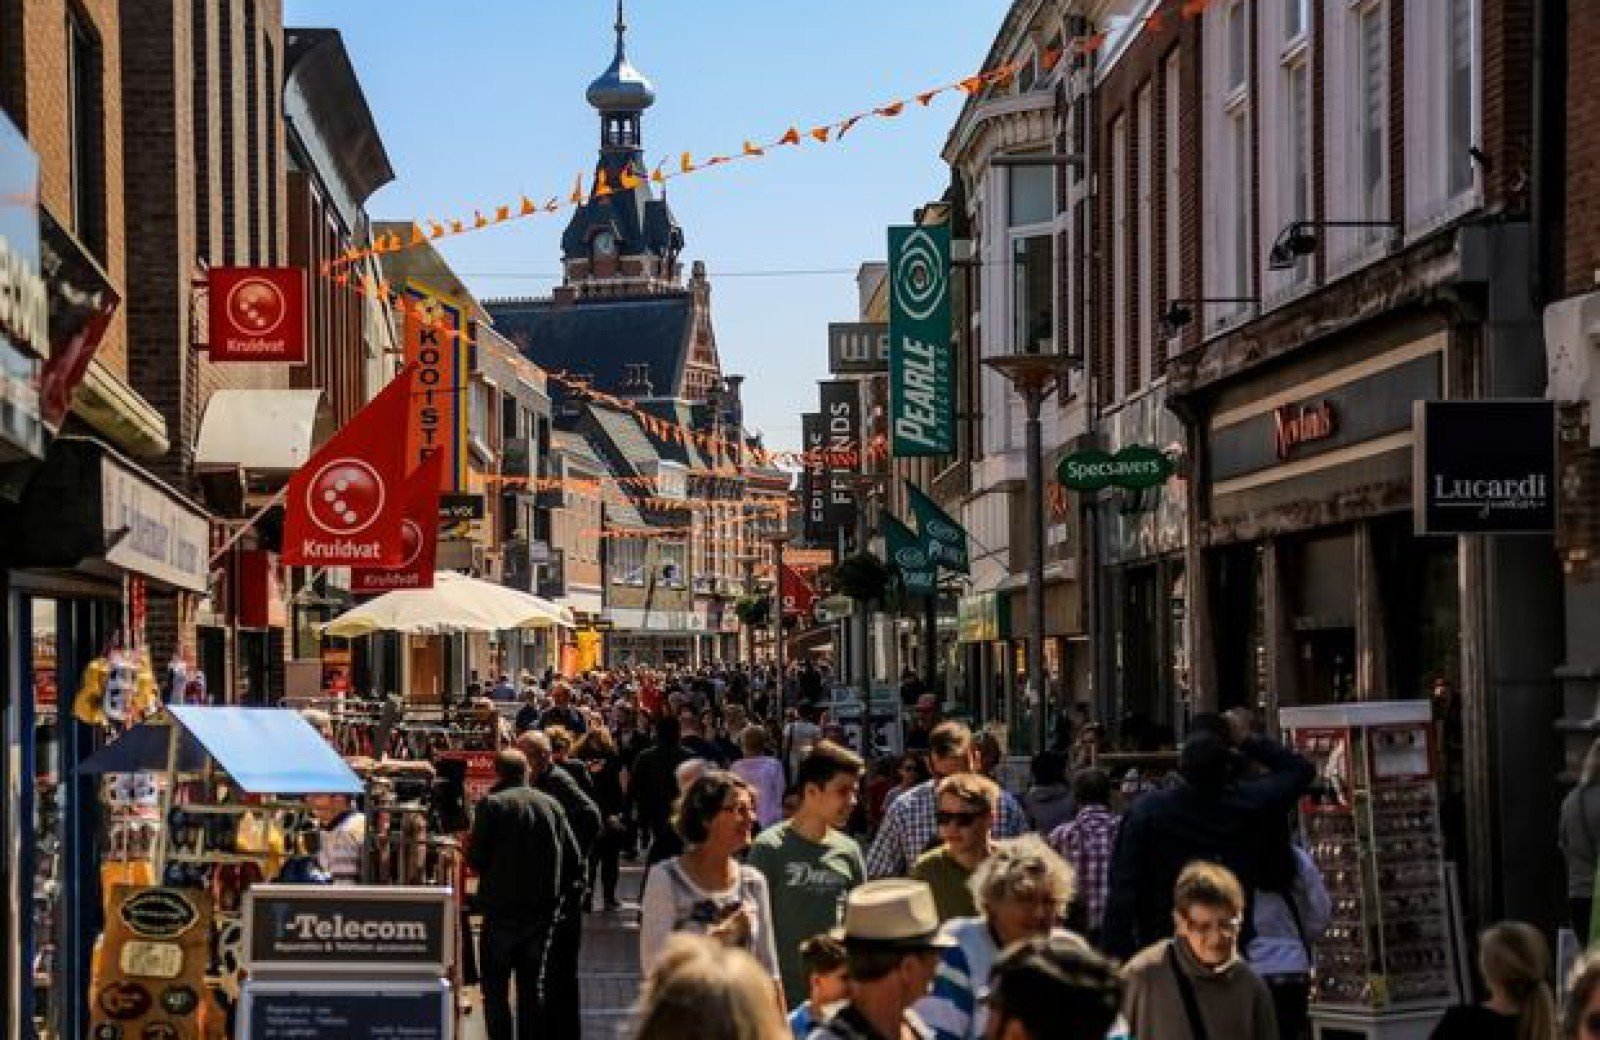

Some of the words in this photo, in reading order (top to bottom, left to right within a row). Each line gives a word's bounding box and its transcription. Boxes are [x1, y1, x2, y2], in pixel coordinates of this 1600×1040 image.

[226, 339, 285, 353] Kruidvat
[1067, 459, 1160, 481] Specsavers
[1434, 474, 1547, 499] Lucardi
[302, 541, 380, 559] Kruidvat
